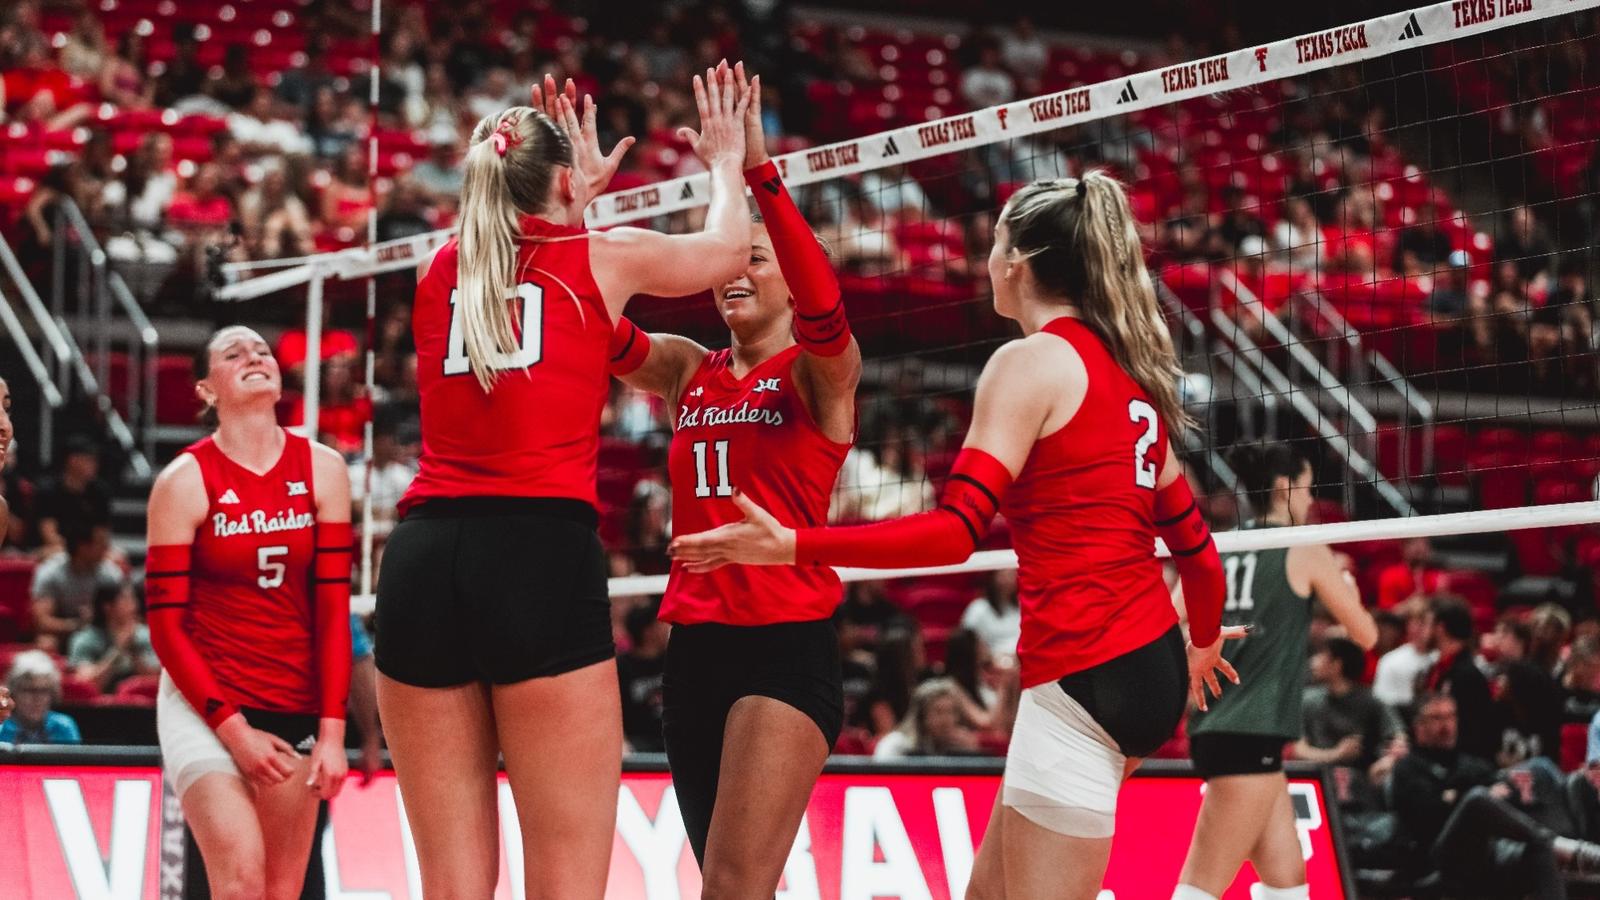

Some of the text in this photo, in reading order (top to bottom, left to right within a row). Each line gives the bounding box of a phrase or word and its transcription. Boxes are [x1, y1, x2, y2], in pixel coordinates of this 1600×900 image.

[1452, 0, 1496, 28] TEXAS
[1296, 24, 1368, 64] TEXAS TECH
[1161, 57, 1229, 94] TEXAS TECH
[1029, 89, 1091, 123] TEXAS TECH
[918, 116, 976, 148] TEXAS TECH
[701, 401, 783, 426] Raiders
[1128, 398, 1158, 489] 2
[692, 440, 733, 498] 11
[212, 511, 252, 537] Red
[257, 546, 289, 589] 5
[1224, 553, 1257, 610] 11
